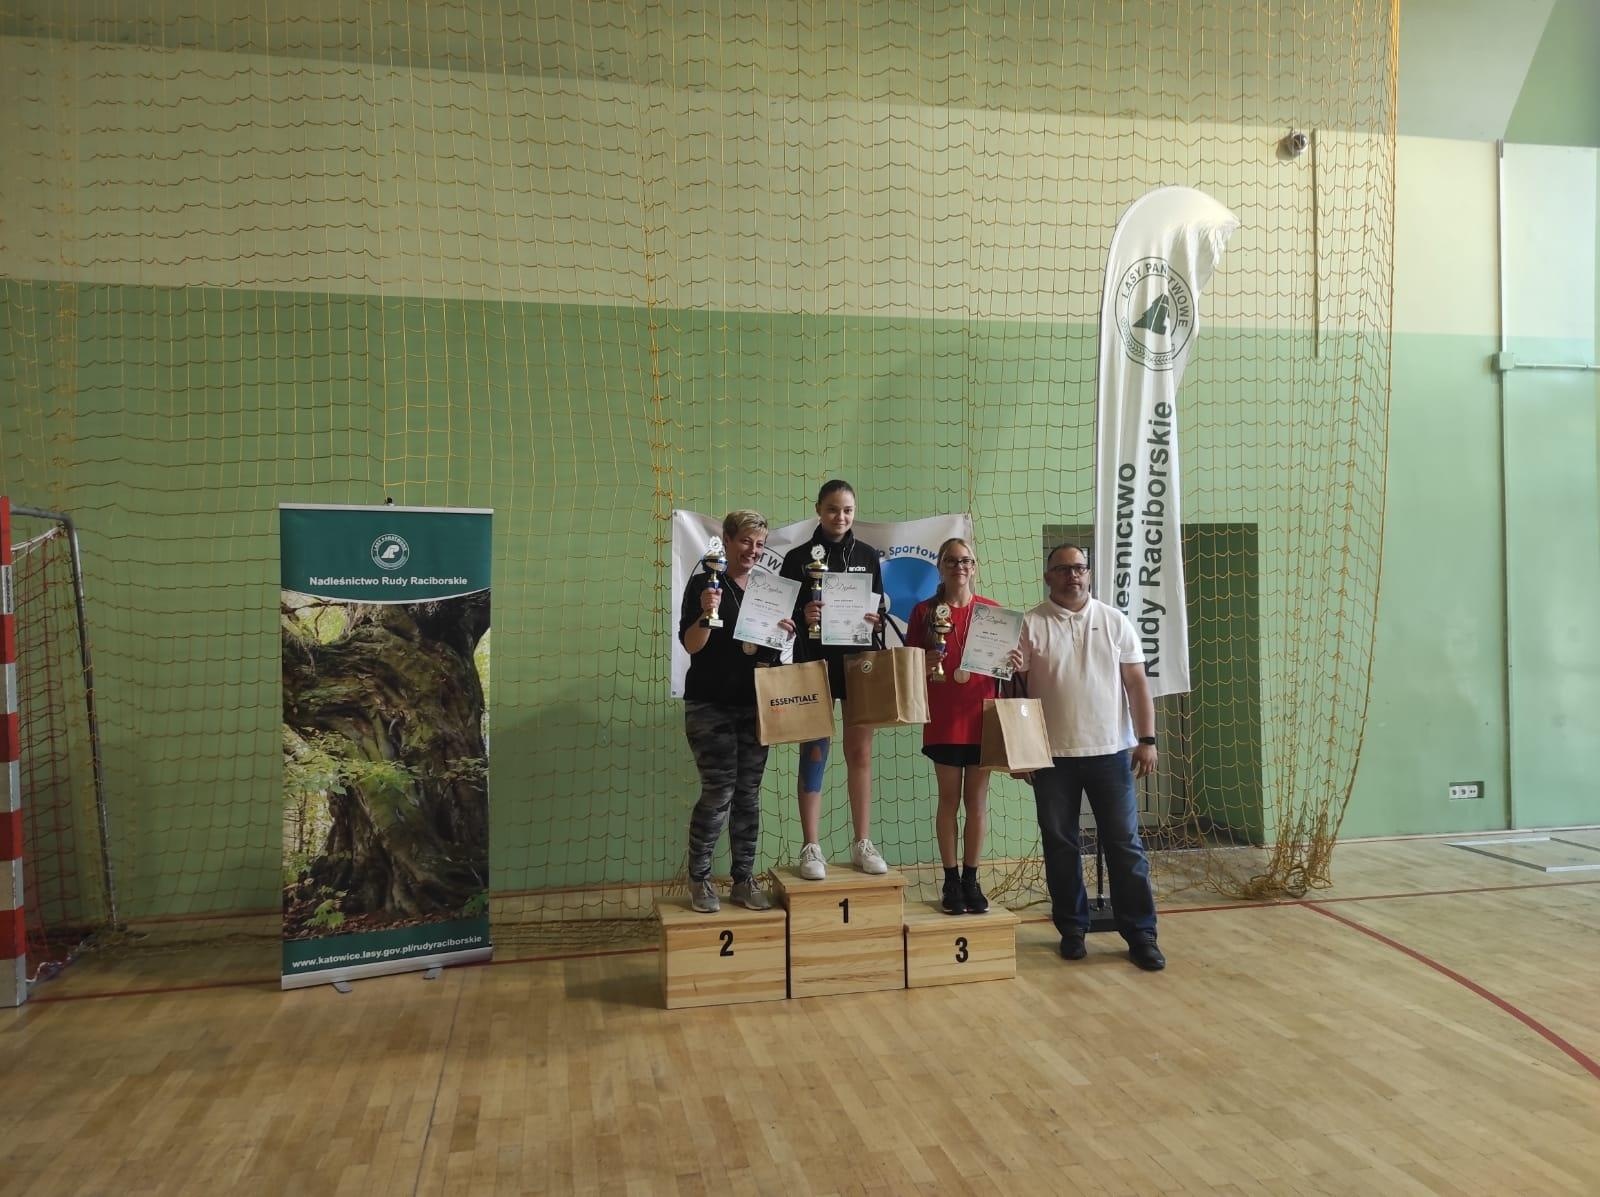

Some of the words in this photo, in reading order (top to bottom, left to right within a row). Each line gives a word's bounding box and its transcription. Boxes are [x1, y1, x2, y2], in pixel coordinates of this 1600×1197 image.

[1121, 266, 1142, 299] LASY
[1138, 401, 1172, 587] Raciborskie
[309, 576, 379, 586] Nadleśnictwo
[381, 576, 408, 587] Rudy
[410, 576, 468, 586] Raciborskie
[1137, 597, 1166, 677] Rudy
[770, 693, 819, 706] ESSENTIALE
[838, 898, 849, 923] 1
[292, 935, 482, 968] www.katowice.lasy.gov.pl/rudyraciborskie
[719, 930, 734, 957] 2
[955, 937, 969, 962] 3
